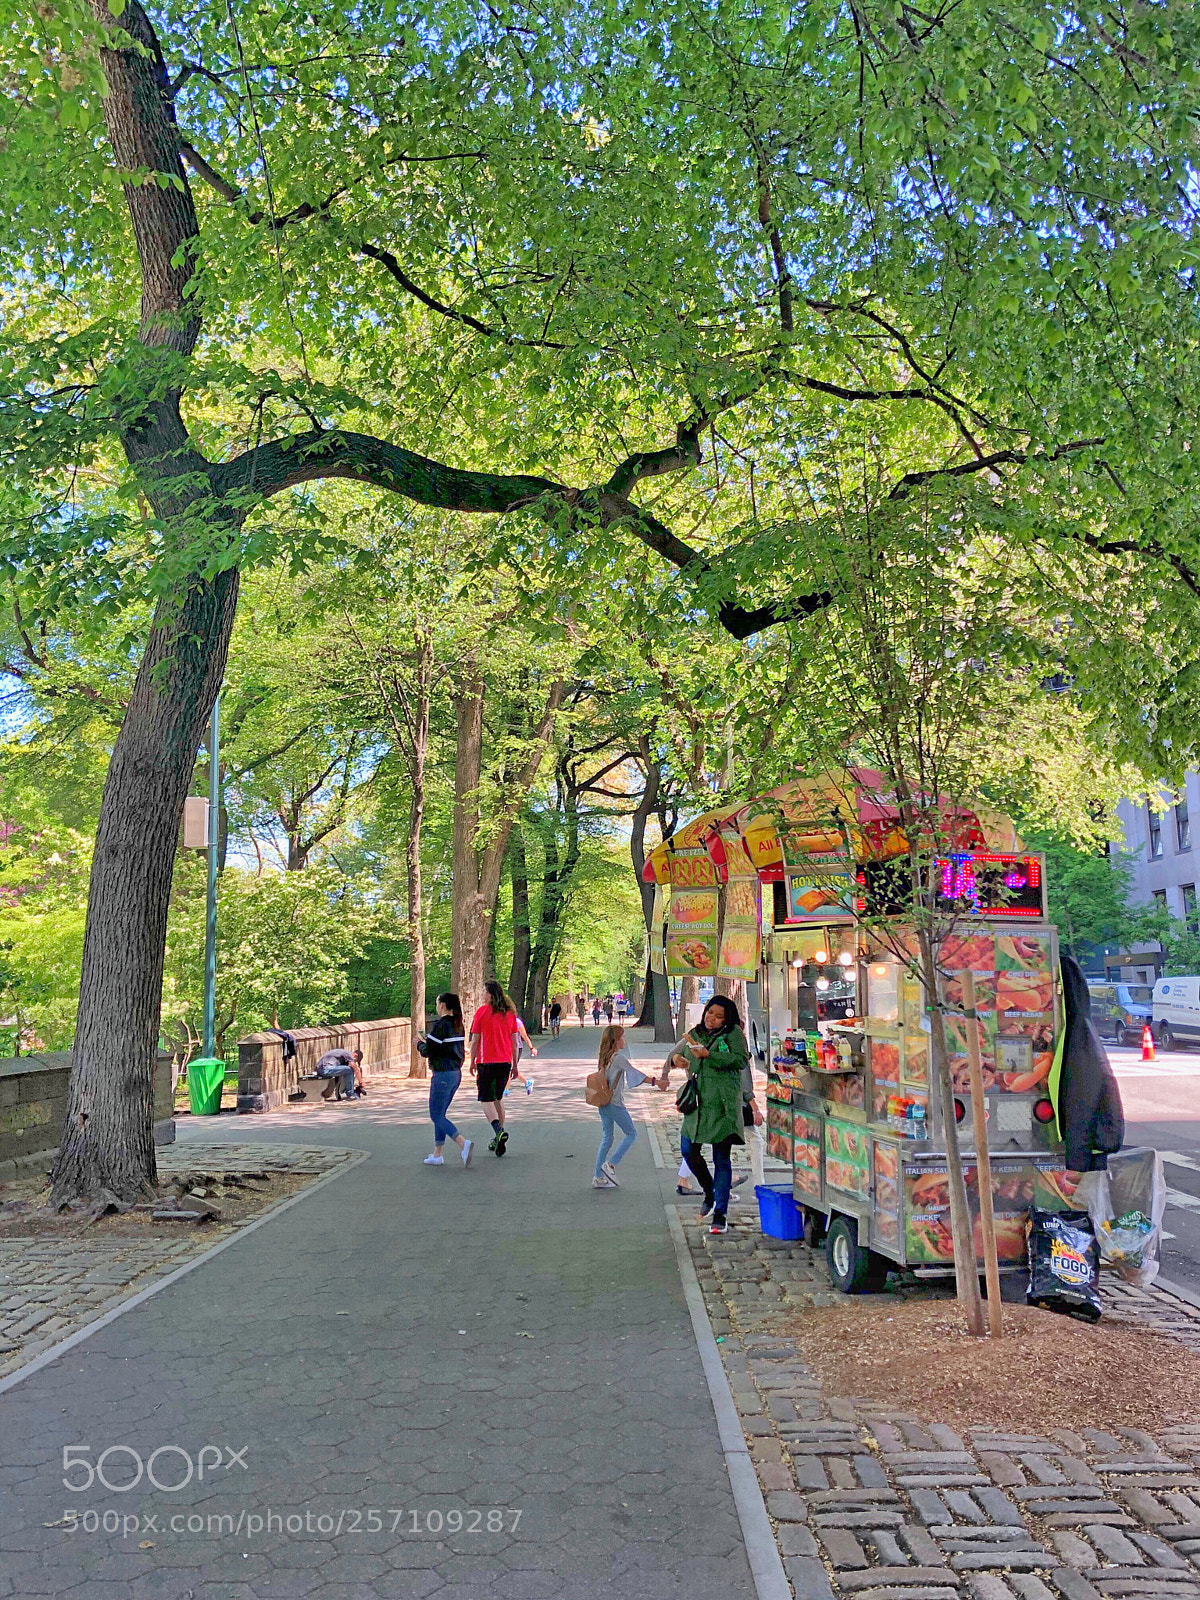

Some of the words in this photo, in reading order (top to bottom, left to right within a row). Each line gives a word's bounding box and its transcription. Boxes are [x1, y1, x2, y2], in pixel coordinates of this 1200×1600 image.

[792, 876, 812, 889] HOT
[905, 1167, 933, 1175] ITALIAN
[999, 1165, 1023, 1173] KEBAB
[1042, 1221, 1060, 1229] LUMP
[1053, 1256, 1088, 1275] FOGO
